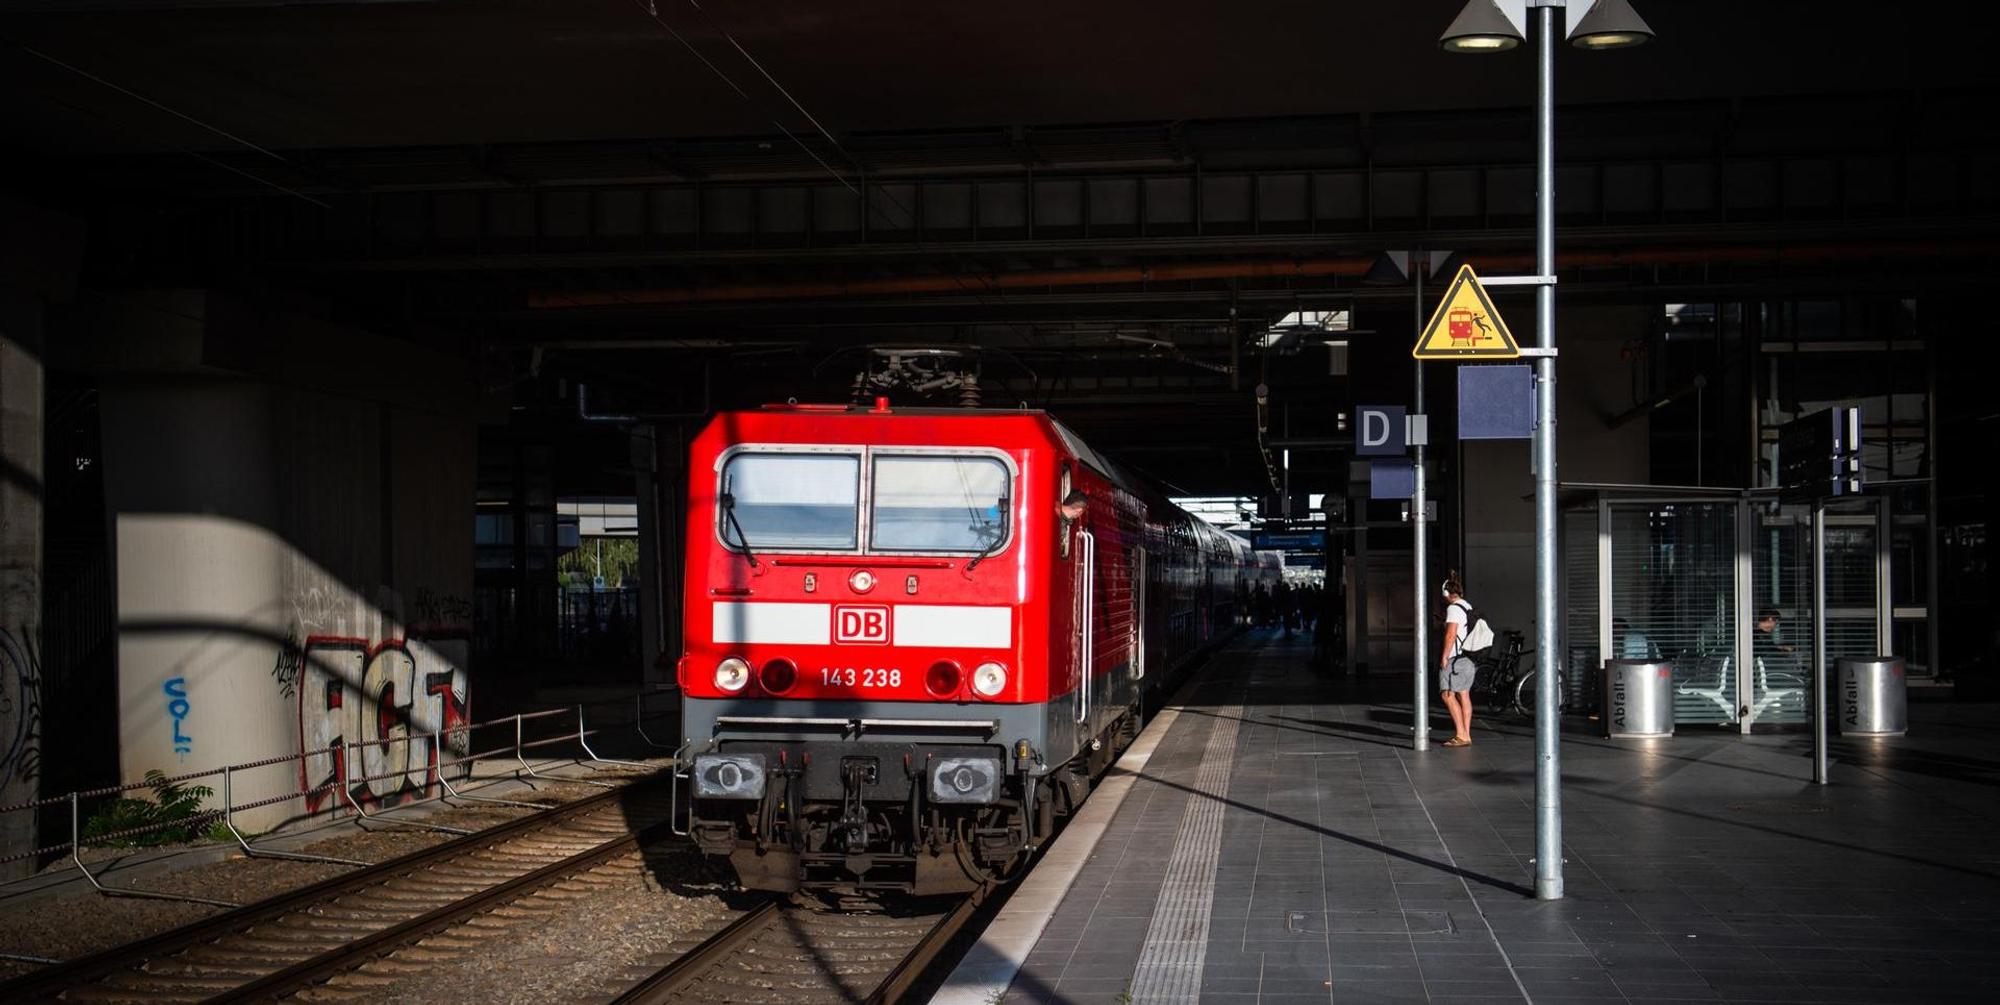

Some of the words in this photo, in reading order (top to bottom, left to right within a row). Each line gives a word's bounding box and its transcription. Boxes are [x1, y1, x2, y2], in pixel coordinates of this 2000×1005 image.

[1363, 410, 1390, 446] D
[842, 611, 883, 638] DB
[821, 667, 856, 687] 143
[862, 668, 902, 688] 238
[1613, 683, 1626, 728] Abfall
[1845, 681, 1858, 726] Abfall
